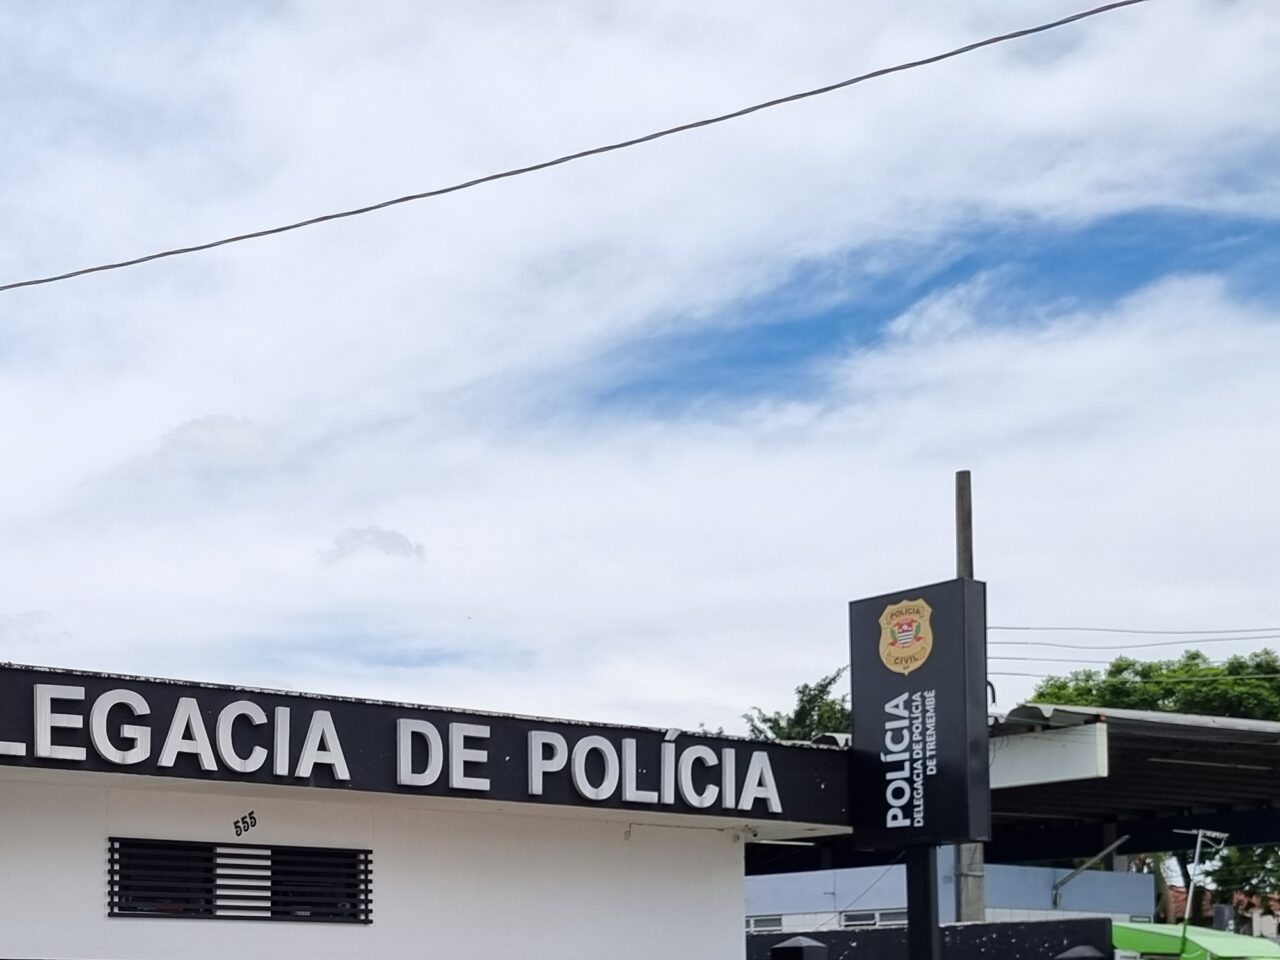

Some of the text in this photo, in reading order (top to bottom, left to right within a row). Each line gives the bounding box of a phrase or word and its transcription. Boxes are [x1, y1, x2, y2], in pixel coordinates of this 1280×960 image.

[890, 607, 921, 618] POLÍCIA
[893, 656, 919, 664] CIVIL
[396, 718, 491, 791] DE
[528, 728, 783, 813] POLÍCIA
[880, 691, 911, 828] POLÍCIA
[910, 691, 924, 827] DELEGACIA DE POLÍCIA
[923, 689, 937, 775] DE TREMEMBÉ
[233, 810, 257, 837] 555
